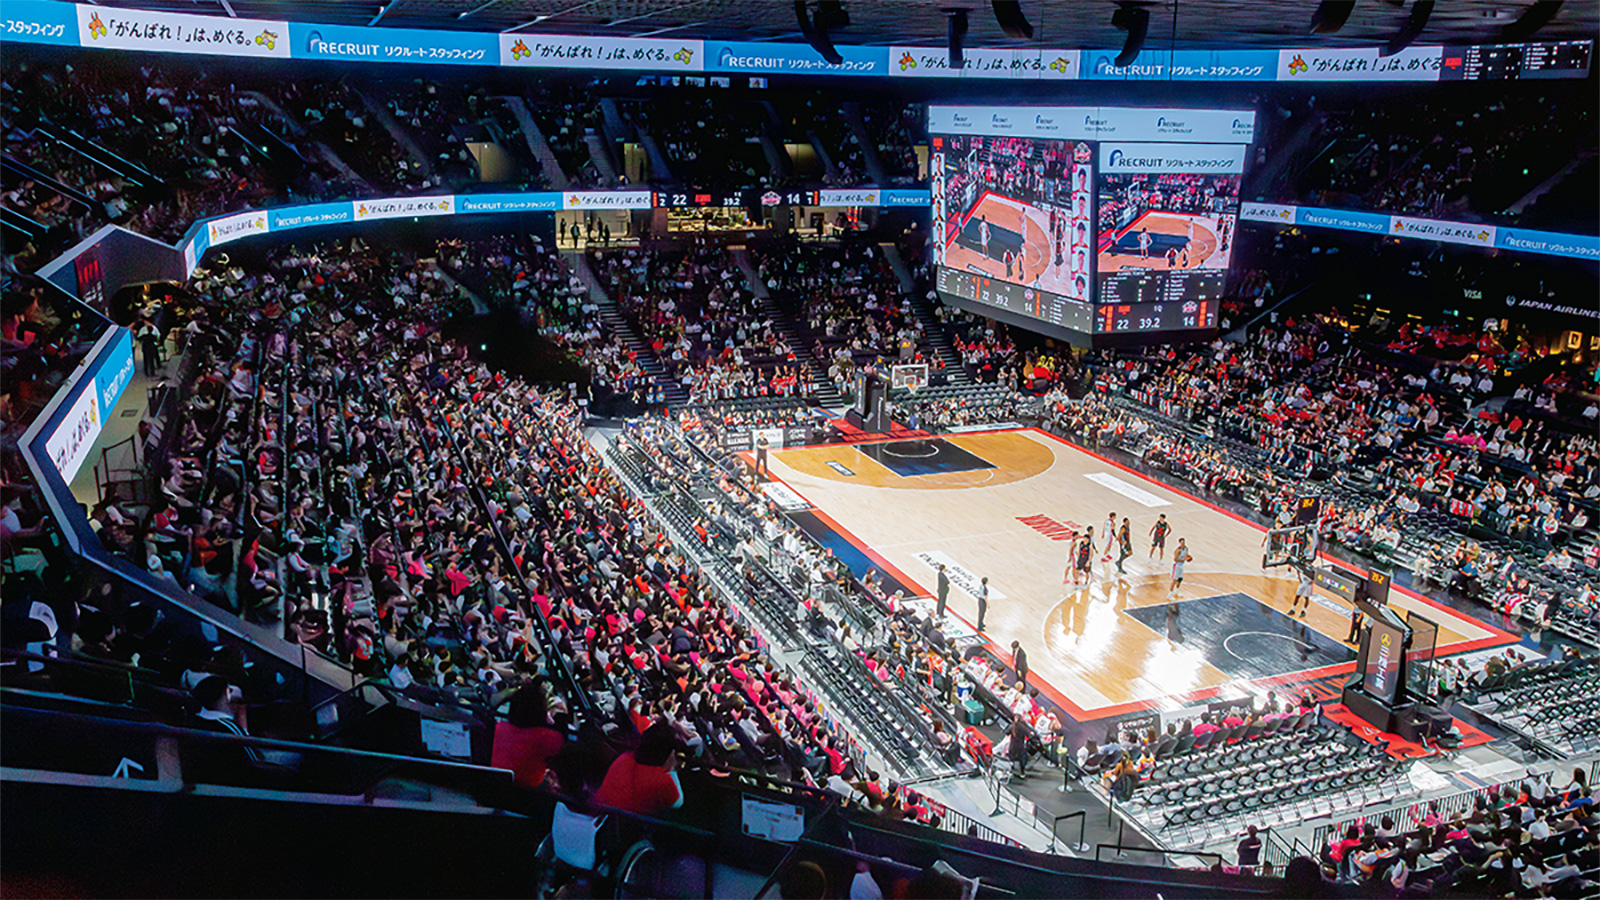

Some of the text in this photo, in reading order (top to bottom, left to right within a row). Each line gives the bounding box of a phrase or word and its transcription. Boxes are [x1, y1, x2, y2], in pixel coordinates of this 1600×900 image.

[318, 42, 380, 56] RECRUIT
[729, 57, 784, 68] RECRUIT
[921, 56, 1047, 71] 「がんれ！」は、めぐる。
[1105, 65, 1164, 76] RECRUIT
[1119, 158, 1163, 167] RECRUIT
[672, 194, 687, 206] 22
[786, 193, 800, 204] 14
[467, 202, 502, 210] RECRUIT
[1508, 238, 1547, 251] RECRUIT
[1463, 288, 1482, 299] VISA
[1518, 298, 1553, 311] JAPAN
[1117, 319, 1129, 330] 22
[1139, 317, 1160, 329] 39.2
[1183, 316, 1195, 326] 14
